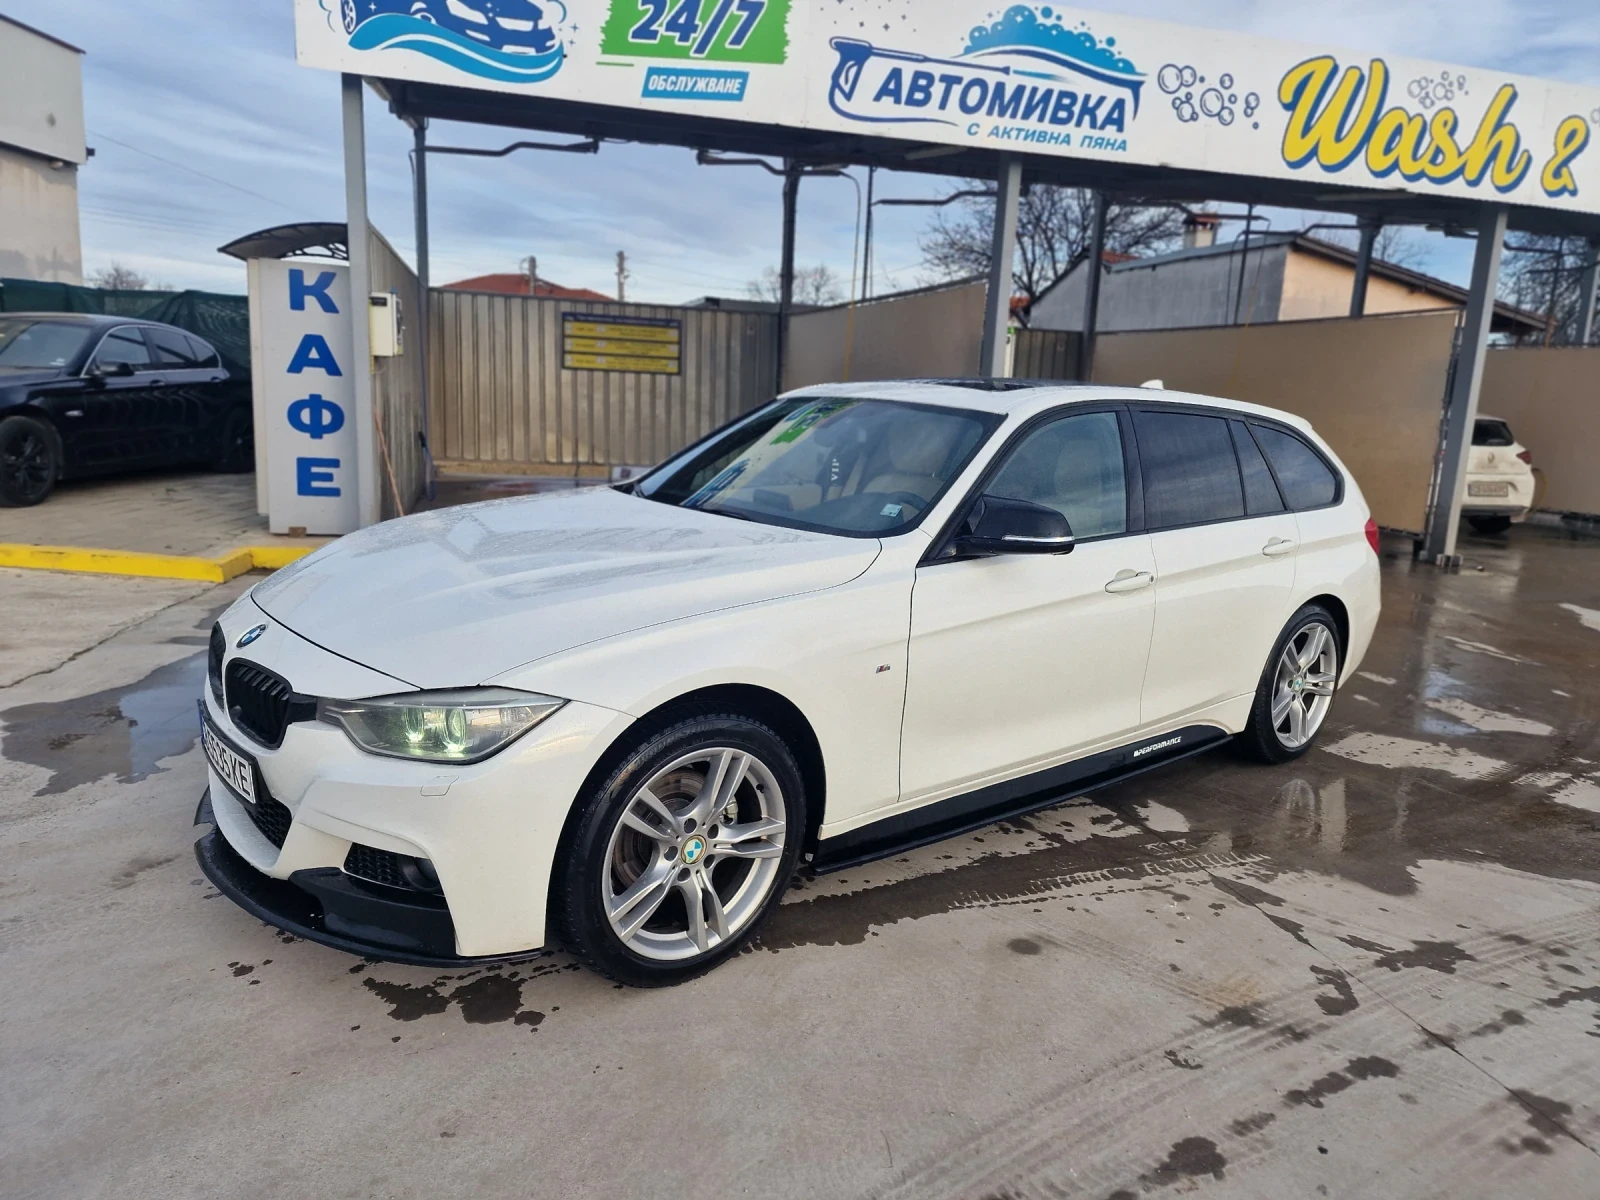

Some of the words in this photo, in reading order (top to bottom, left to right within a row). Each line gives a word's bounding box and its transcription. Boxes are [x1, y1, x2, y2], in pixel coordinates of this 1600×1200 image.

[628, 0, 768, 57] 24/7
[647, 75, 743, 94] ОБСЛУЖВАНЕ
[873, 67, 1126, 133] АВТОМИВКА
[987, 125, 1072, 146] АКТИВНА
[1079, 135, 1128, 152] ПЯНА
[1278, 55, 1532, 193] Wash
[1541, 114, 1590, 198] &
[286, 268, 345, 498] КАФЕ
